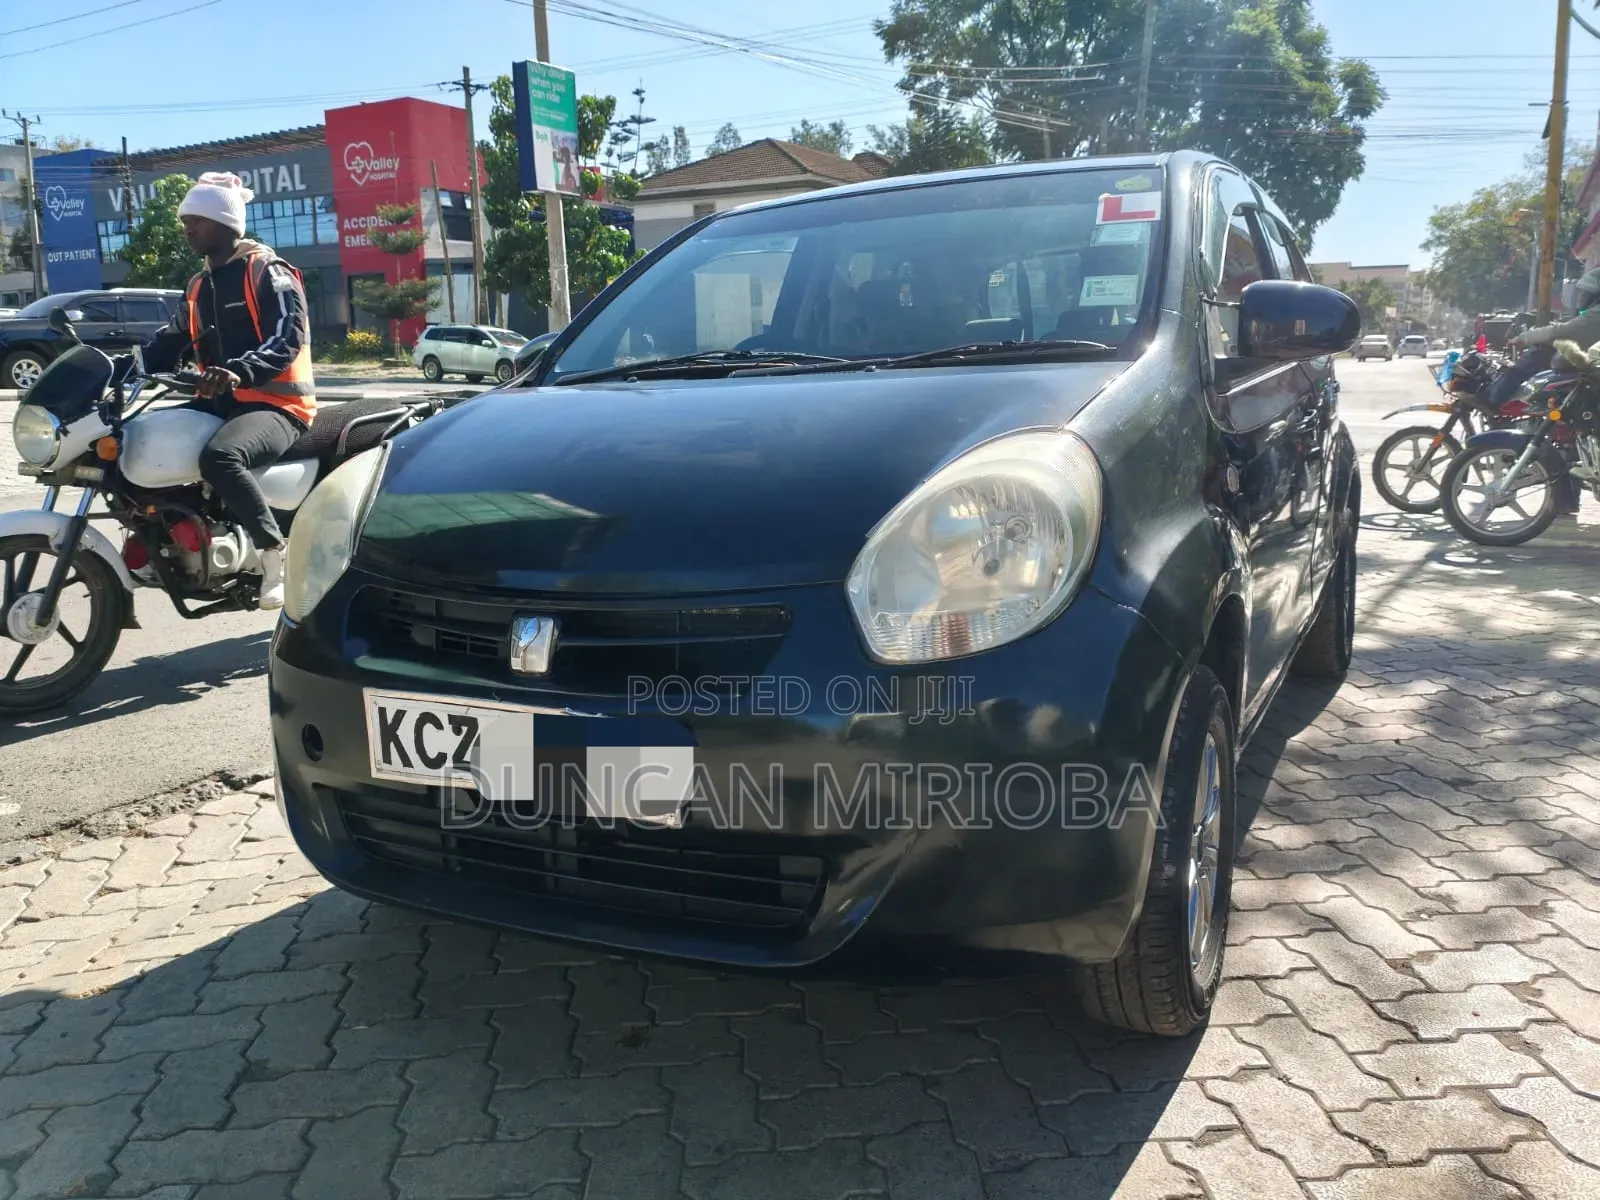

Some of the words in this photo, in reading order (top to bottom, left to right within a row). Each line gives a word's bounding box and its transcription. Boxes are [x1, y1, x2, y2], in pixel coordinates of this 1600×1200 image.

[1101, 195, 1156, 222] L
[48, 252, 63, 262] OUT
[65, 249, 97, 262] PATIENT
